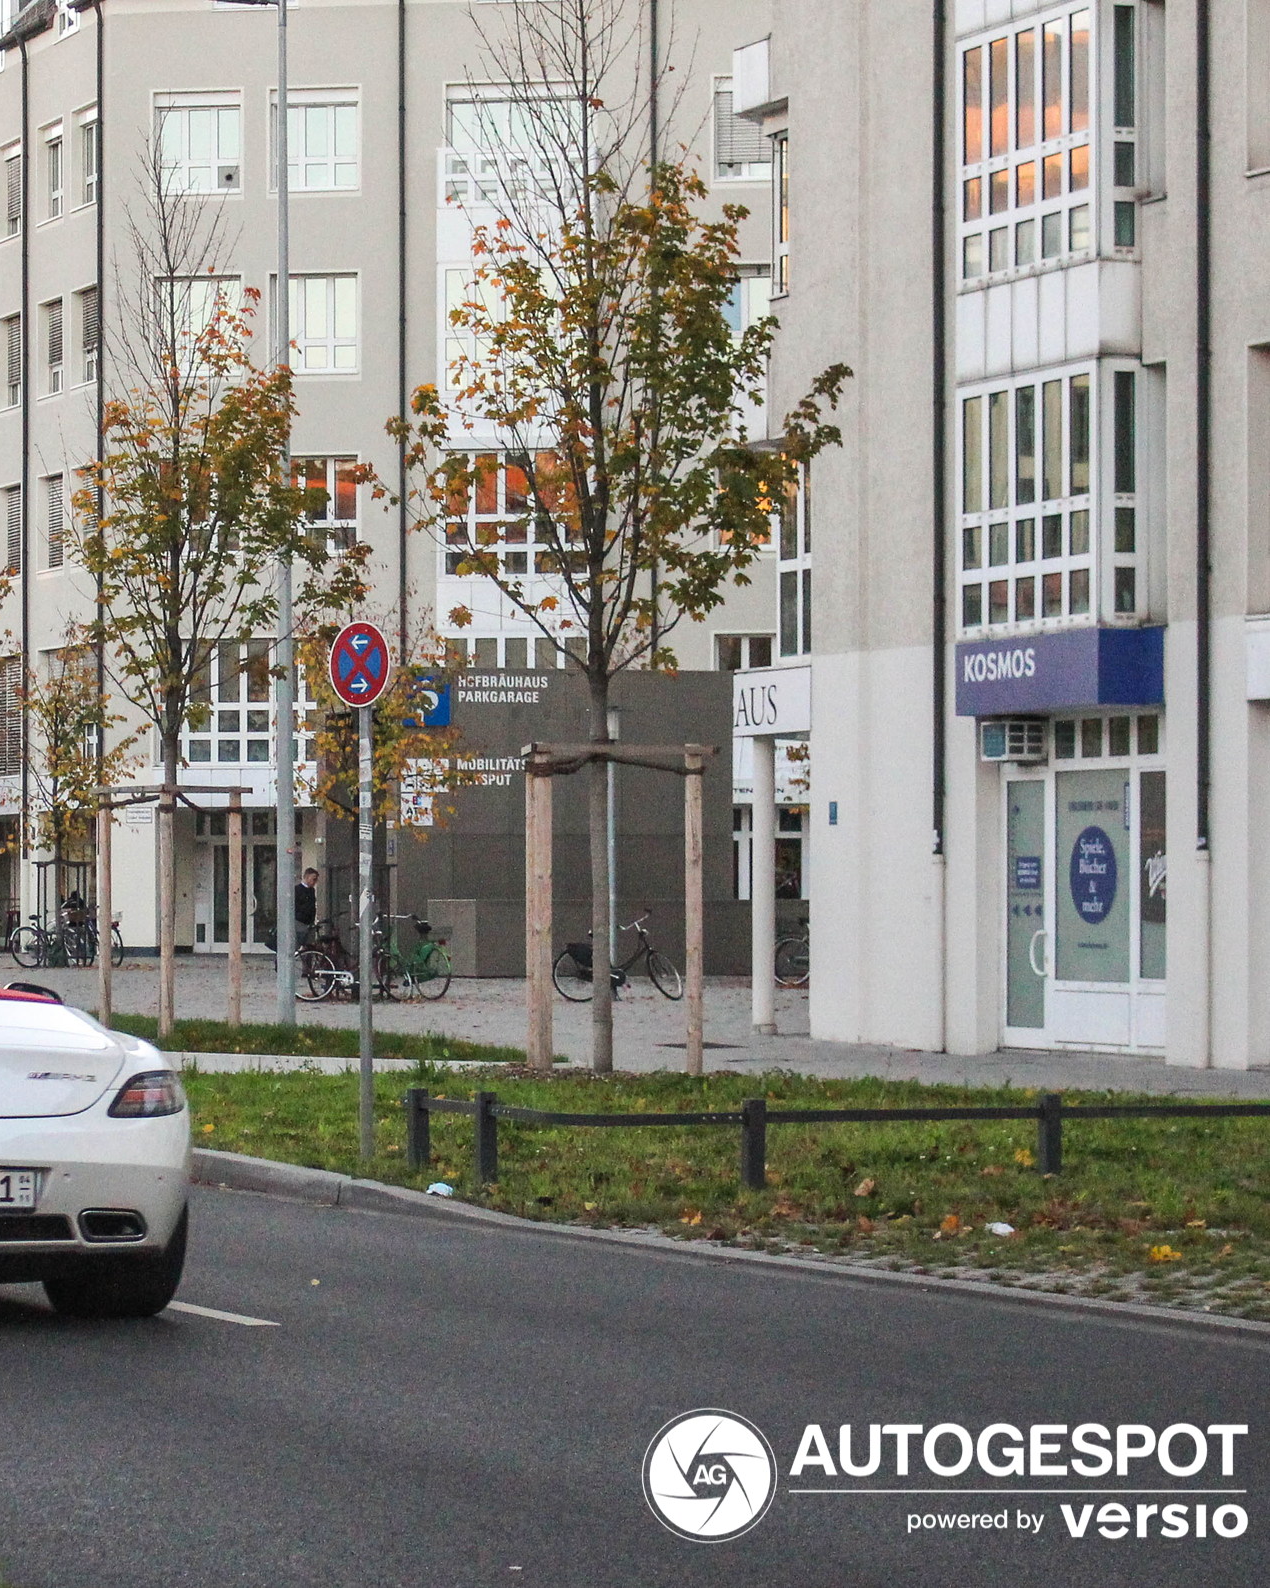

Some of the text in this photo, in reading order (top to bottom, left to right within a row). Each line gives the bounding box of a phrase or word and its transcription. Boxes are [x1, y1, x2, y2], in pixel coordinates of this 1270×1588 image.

[963, 648, 1036, 682] KOSMOS
[458, 674, 548, 688] HOFBRÄUHAUS
[458, 691, 539, 703] PARKGARAGE
[406, 807, 428, 815] AT
